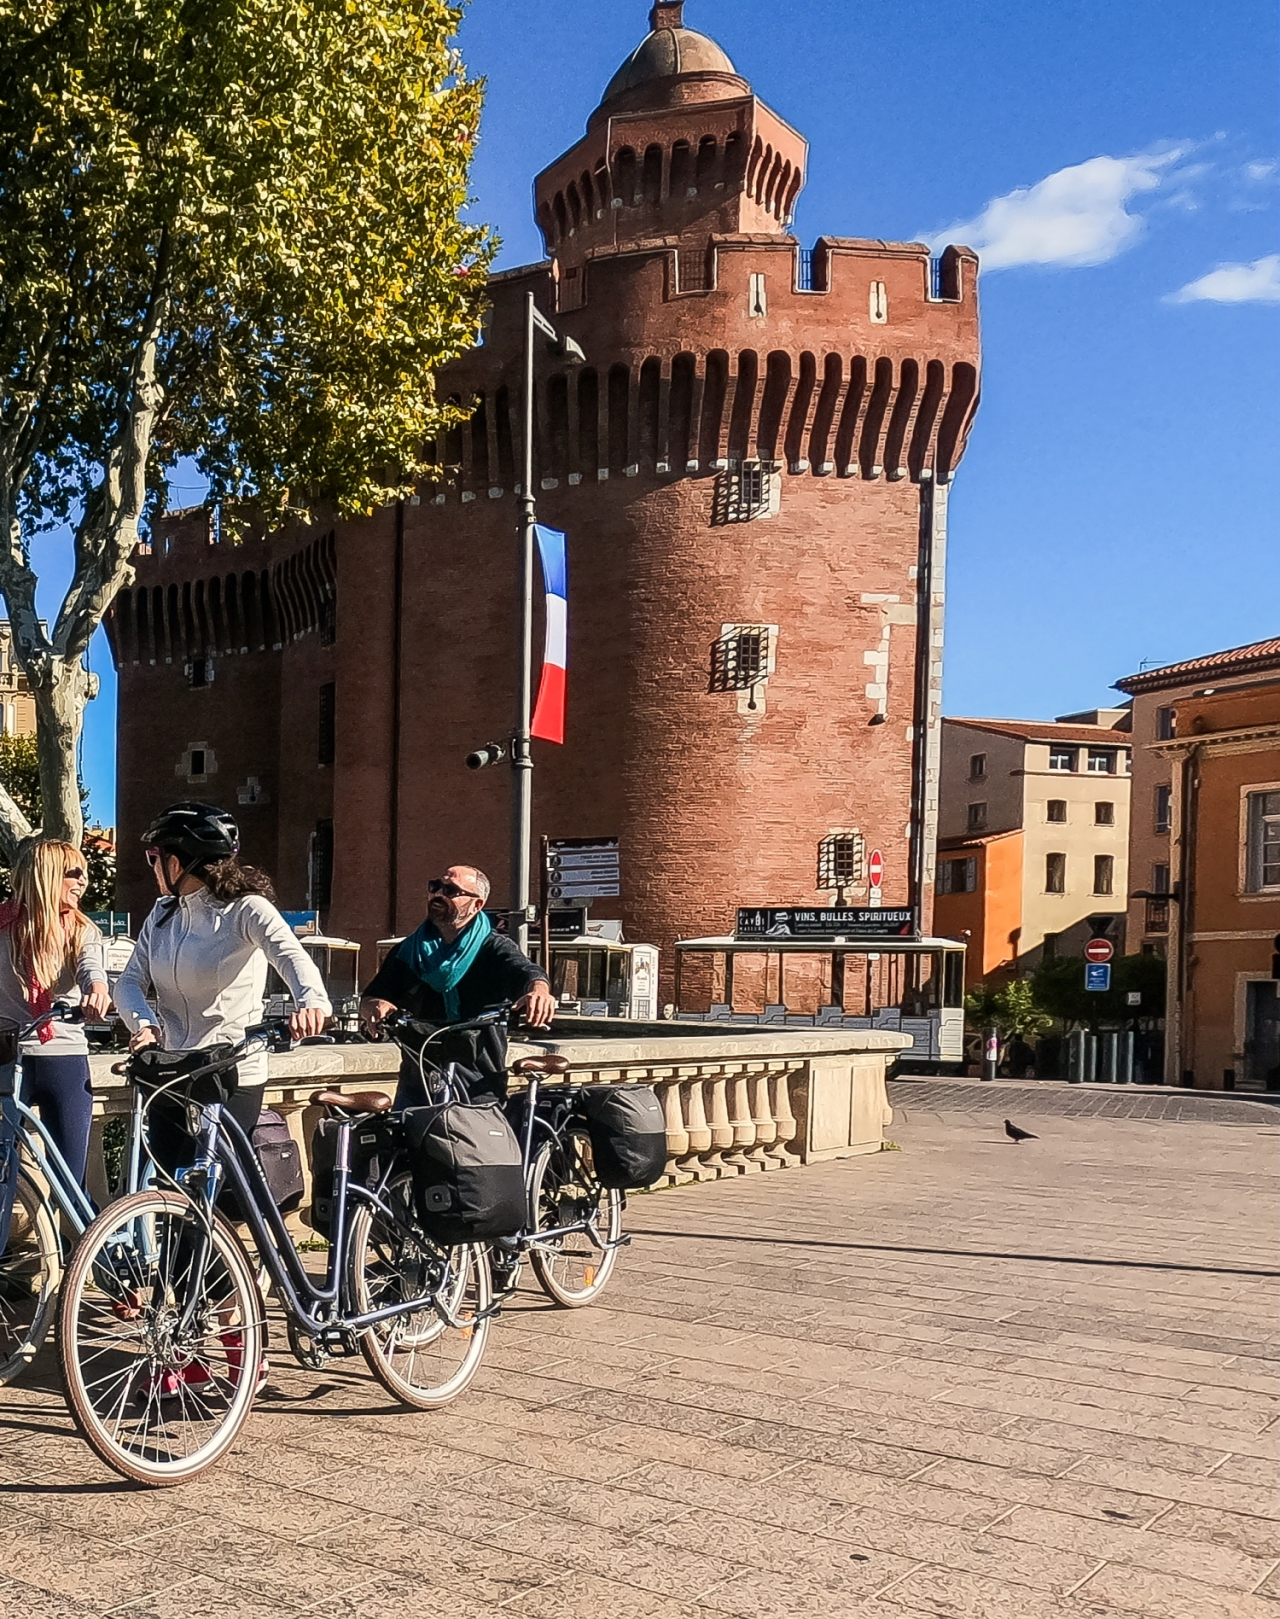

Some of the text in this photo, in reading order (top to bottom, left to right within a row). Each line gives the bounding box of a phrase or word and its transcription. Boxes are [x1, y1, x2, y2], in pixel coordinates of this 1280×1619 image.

[794, 911, 912, 922] VINS, BULLES, SPIRITUEUX
